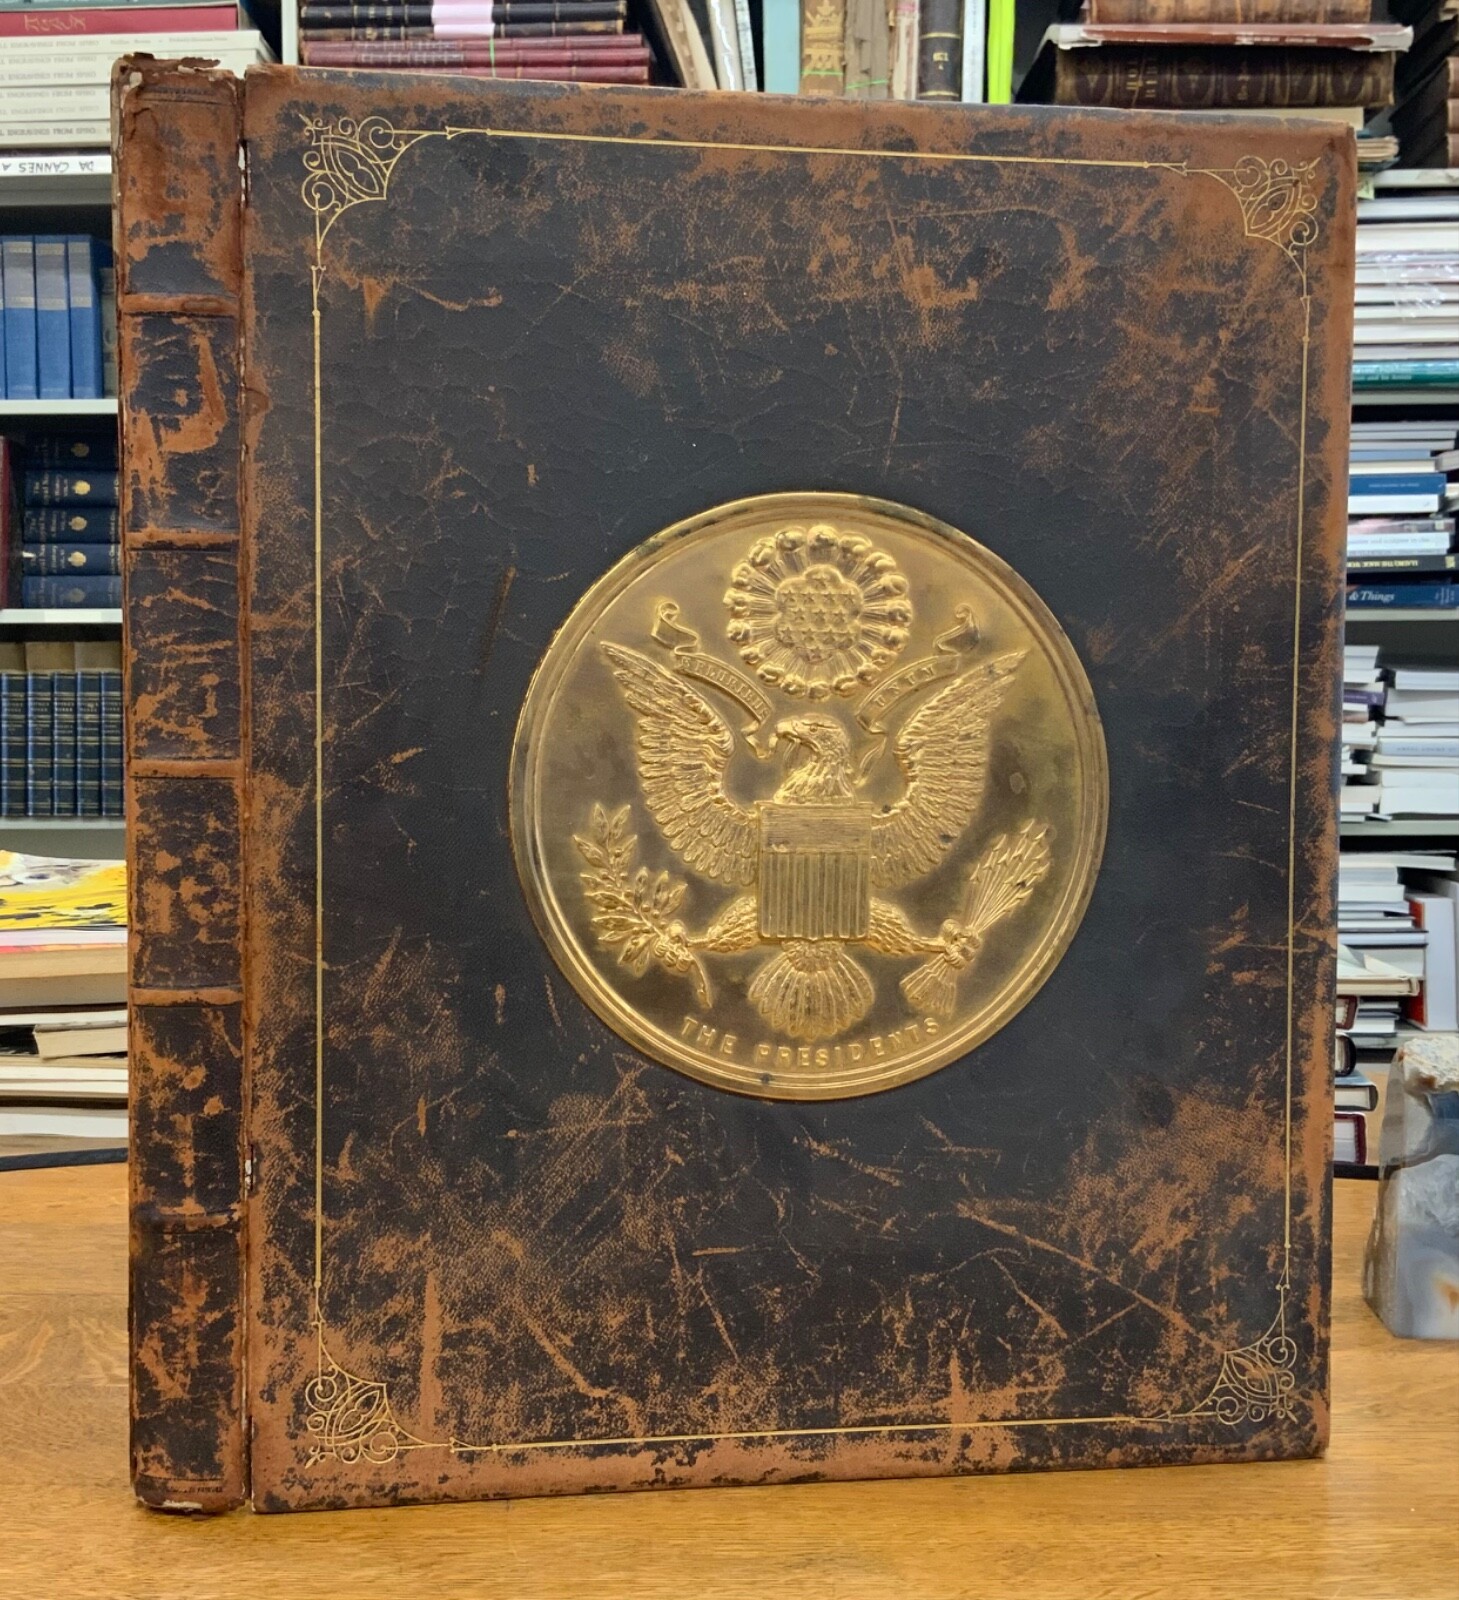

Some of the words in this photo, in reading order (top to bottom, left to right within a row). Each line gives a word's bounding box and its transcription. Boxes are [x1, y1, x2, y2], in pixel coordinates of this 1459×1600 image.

[18, 161, 70, 174] CANNES
[78, 160, 95, 173] DA
[1348, 591, 1359, 601] &
[1360, 589, 1395, 604] Things
[680, 1016, 738, 1054] THE
[754, 1017, 940, 1067] PRESIDENTS
